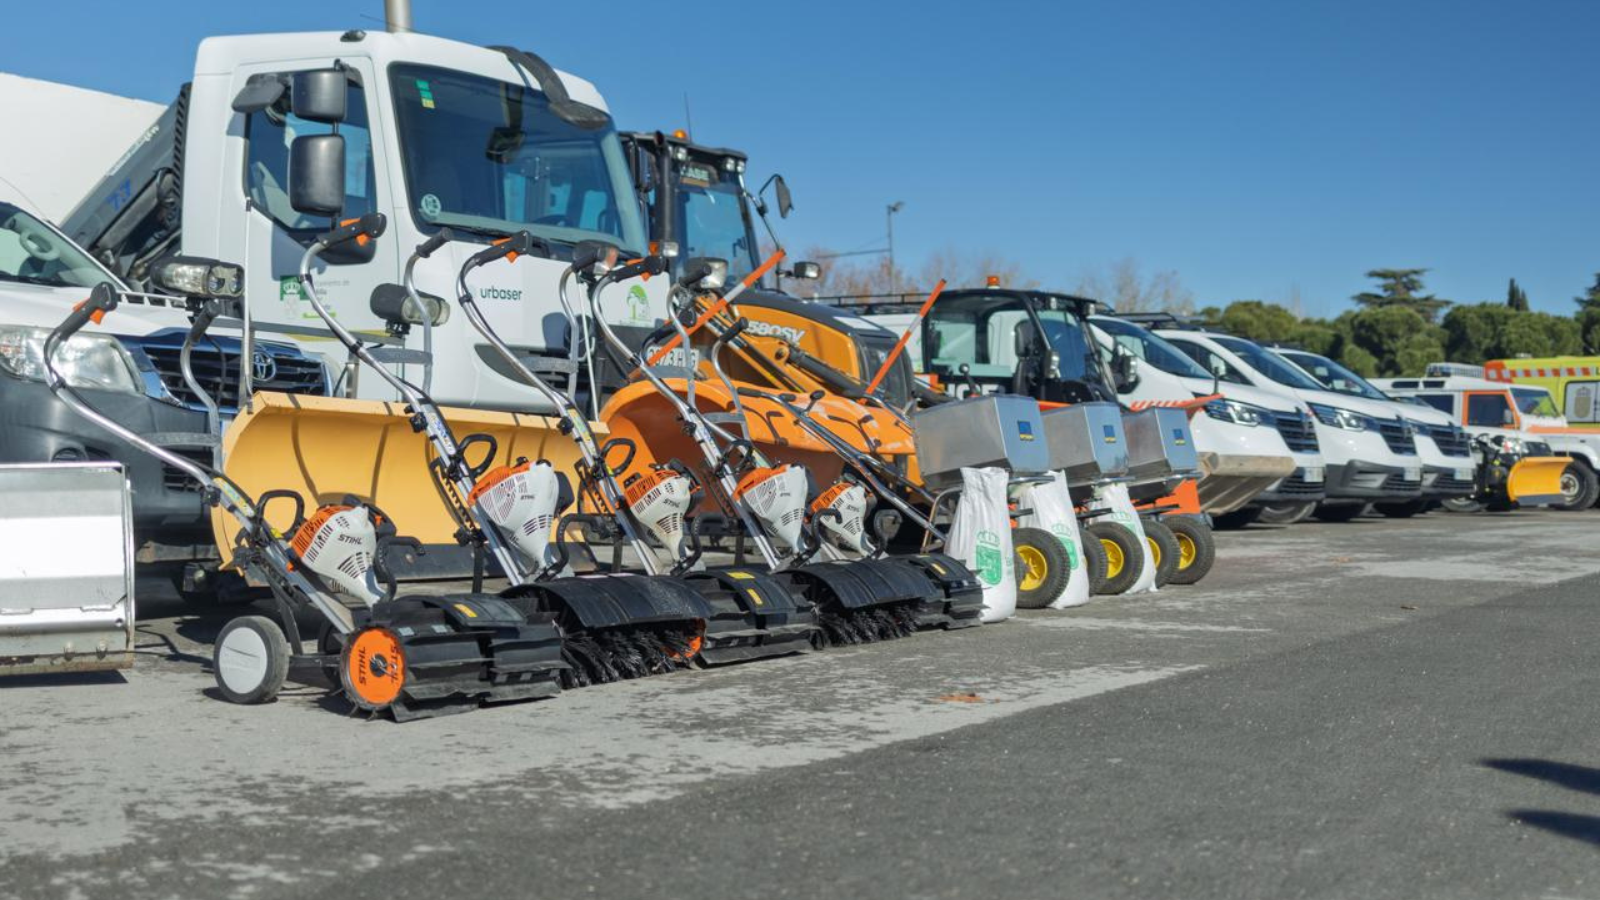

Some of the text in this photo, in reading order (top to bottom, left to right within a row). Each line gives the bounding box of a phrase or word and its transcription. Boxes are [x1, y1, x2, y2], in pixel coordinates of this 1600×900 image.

[480, 285, 522, 301] urbaser
[338, 534, 362, 545] STIHL
[358, 646, 367, 686] STIHL
